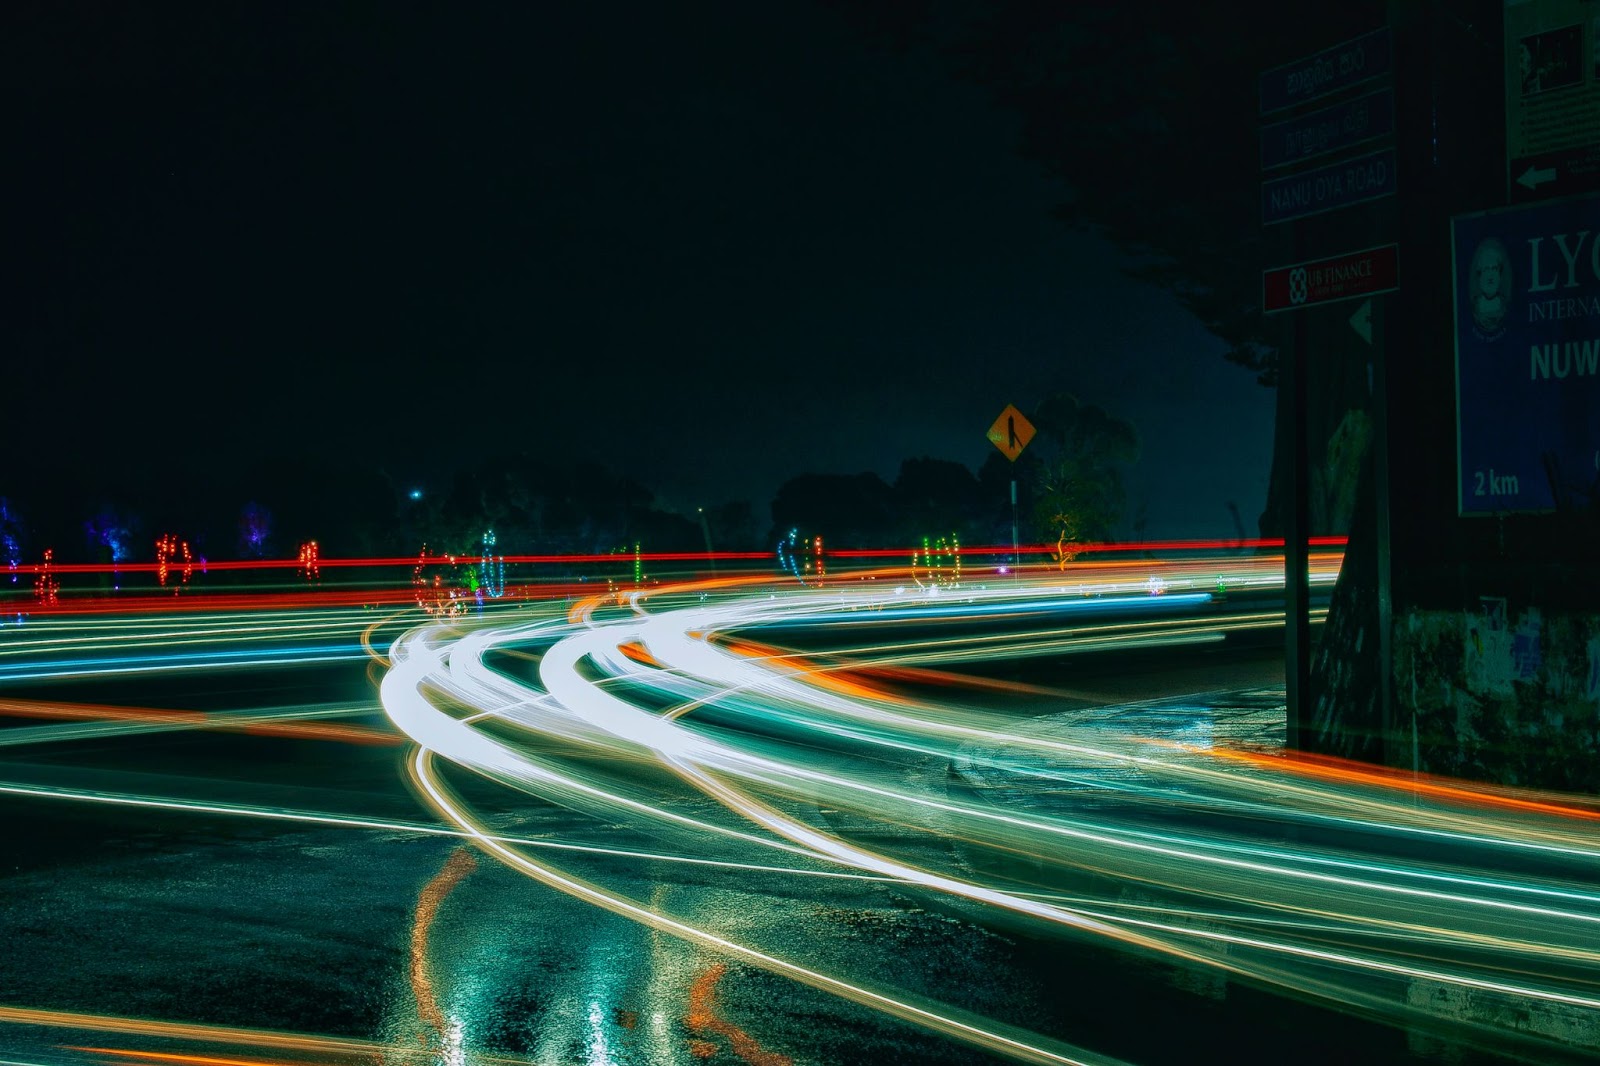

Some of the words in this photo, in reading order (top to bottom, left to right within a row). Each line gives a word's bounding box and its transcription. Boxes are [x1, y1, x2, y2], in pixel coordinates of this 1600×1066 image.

[1270, 181, 1312, 214] NANU
[1315, 174, 1344, 201] OYA
[1345, 160, 1387, 192] ROAD
[1308, 269, 1322, 288] UB
[1323, 258, 1373, 284] FINANCE
[1528, 296, 1600, 323] INTERNA
[1530, 339, 1600, 381] NUW
[1473, 471, 1486, 496] 2
[1489, 468, 1519, 496] km
